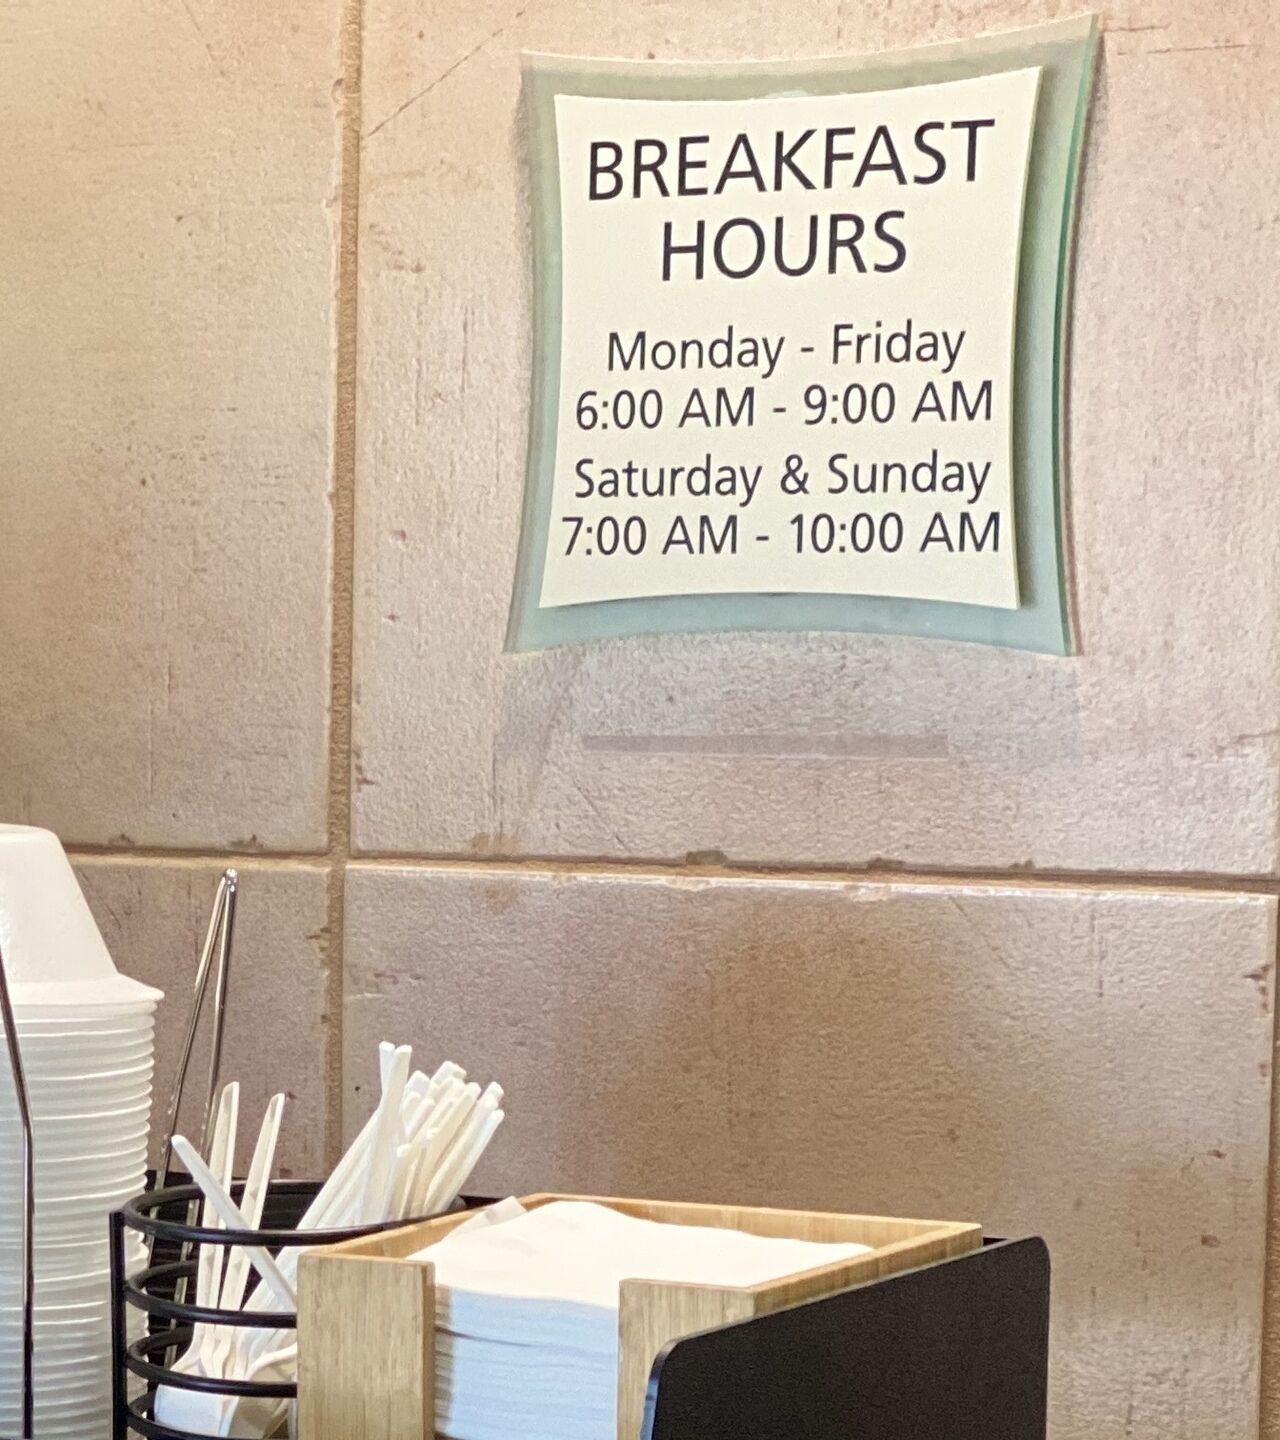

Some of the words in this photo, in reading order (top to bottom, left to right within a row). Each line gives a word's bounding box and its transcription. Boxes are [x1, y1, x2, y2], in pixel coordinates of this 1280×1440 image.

[588, 119, 995, 201] BREAKFAST
[661, 210, 907, 282] HOURS
[607, 326, 785, 378] Monday
[832, 319, 966, 373] Friday
[576, 389, 662, 430] 6:00
[678, 387, 755, 427] AM
[803, 383, 896, 425] 9:00
[912, 380, 993, 421] AM
[574, 454, 762, 506] Saturday
[780, 457, 810, 493] &
[828, 449, 992, 504] Sunday
[562, 516, 646, 556] 7:00
[662, 515, 738, 555] AM
[790, 512, 904, 554] 10:00
[920, 512, 1000, 552] AM
